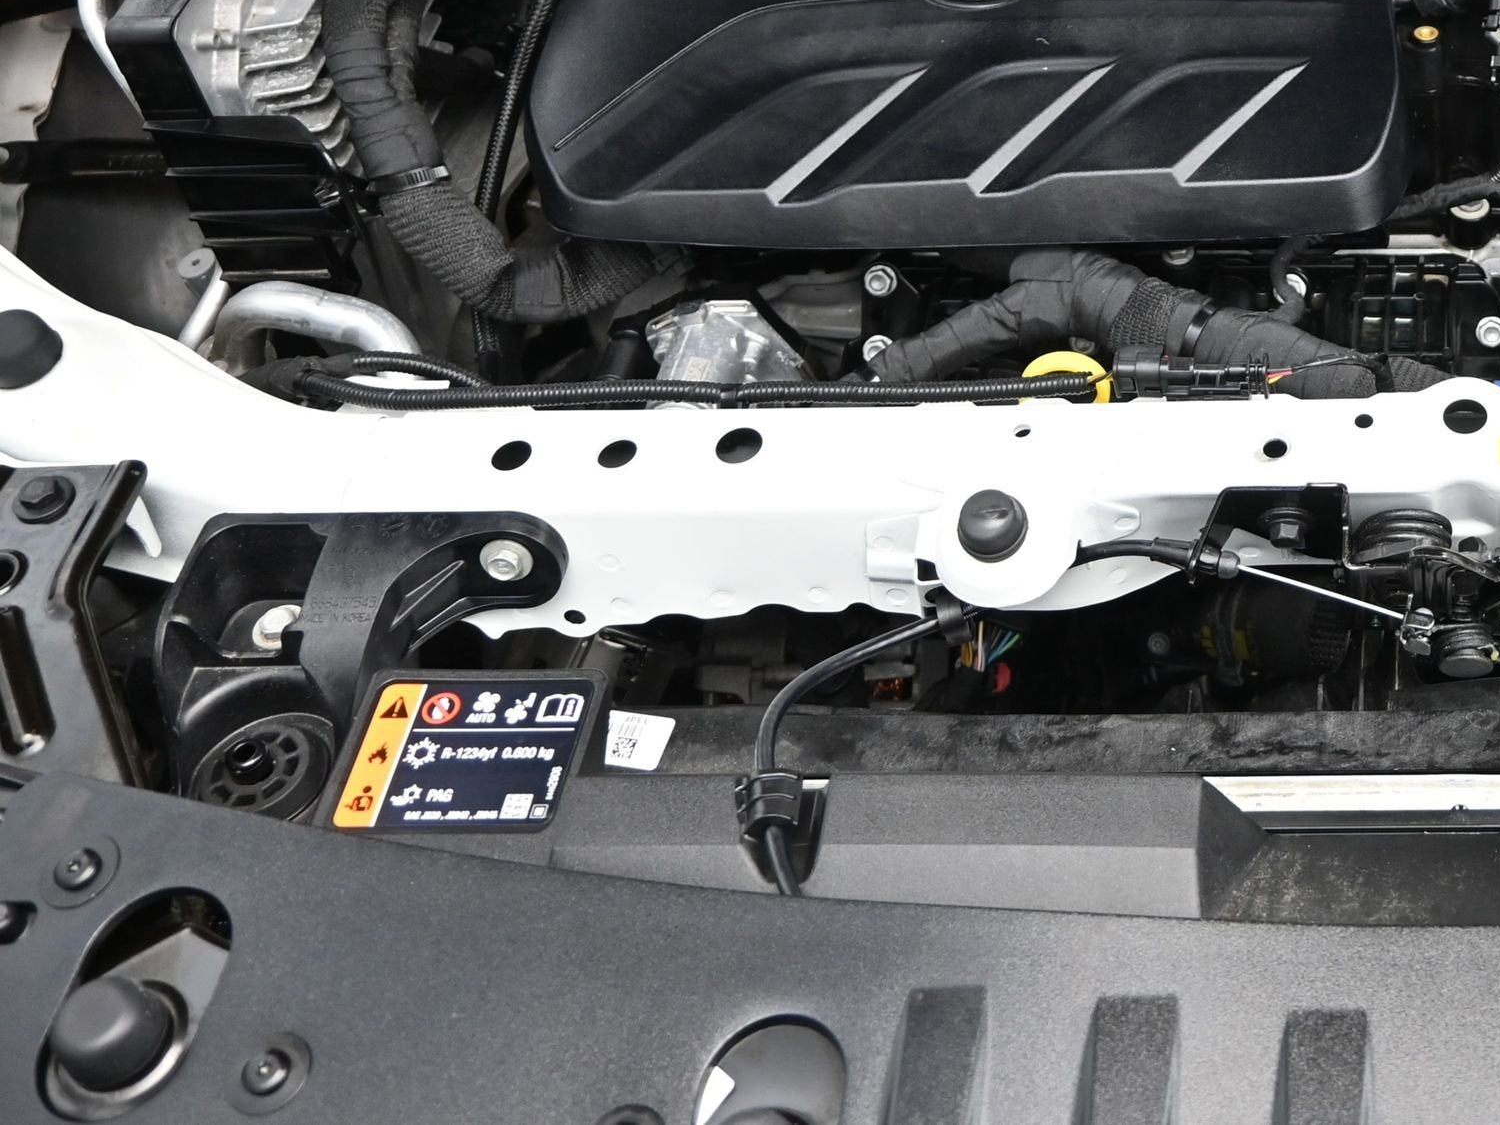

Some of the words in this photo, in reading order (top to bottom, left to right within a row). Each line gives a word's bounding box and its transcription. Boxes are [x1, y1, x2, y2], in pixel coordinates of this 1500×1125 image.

[465, 712, 497, 724] AUTO
[441, 747, 498, 762] R-1234yf
[501, 747, 537, 759] 0.600
[537, 746, 555, 761] kg
[425, 788, 455, 803] PAG
